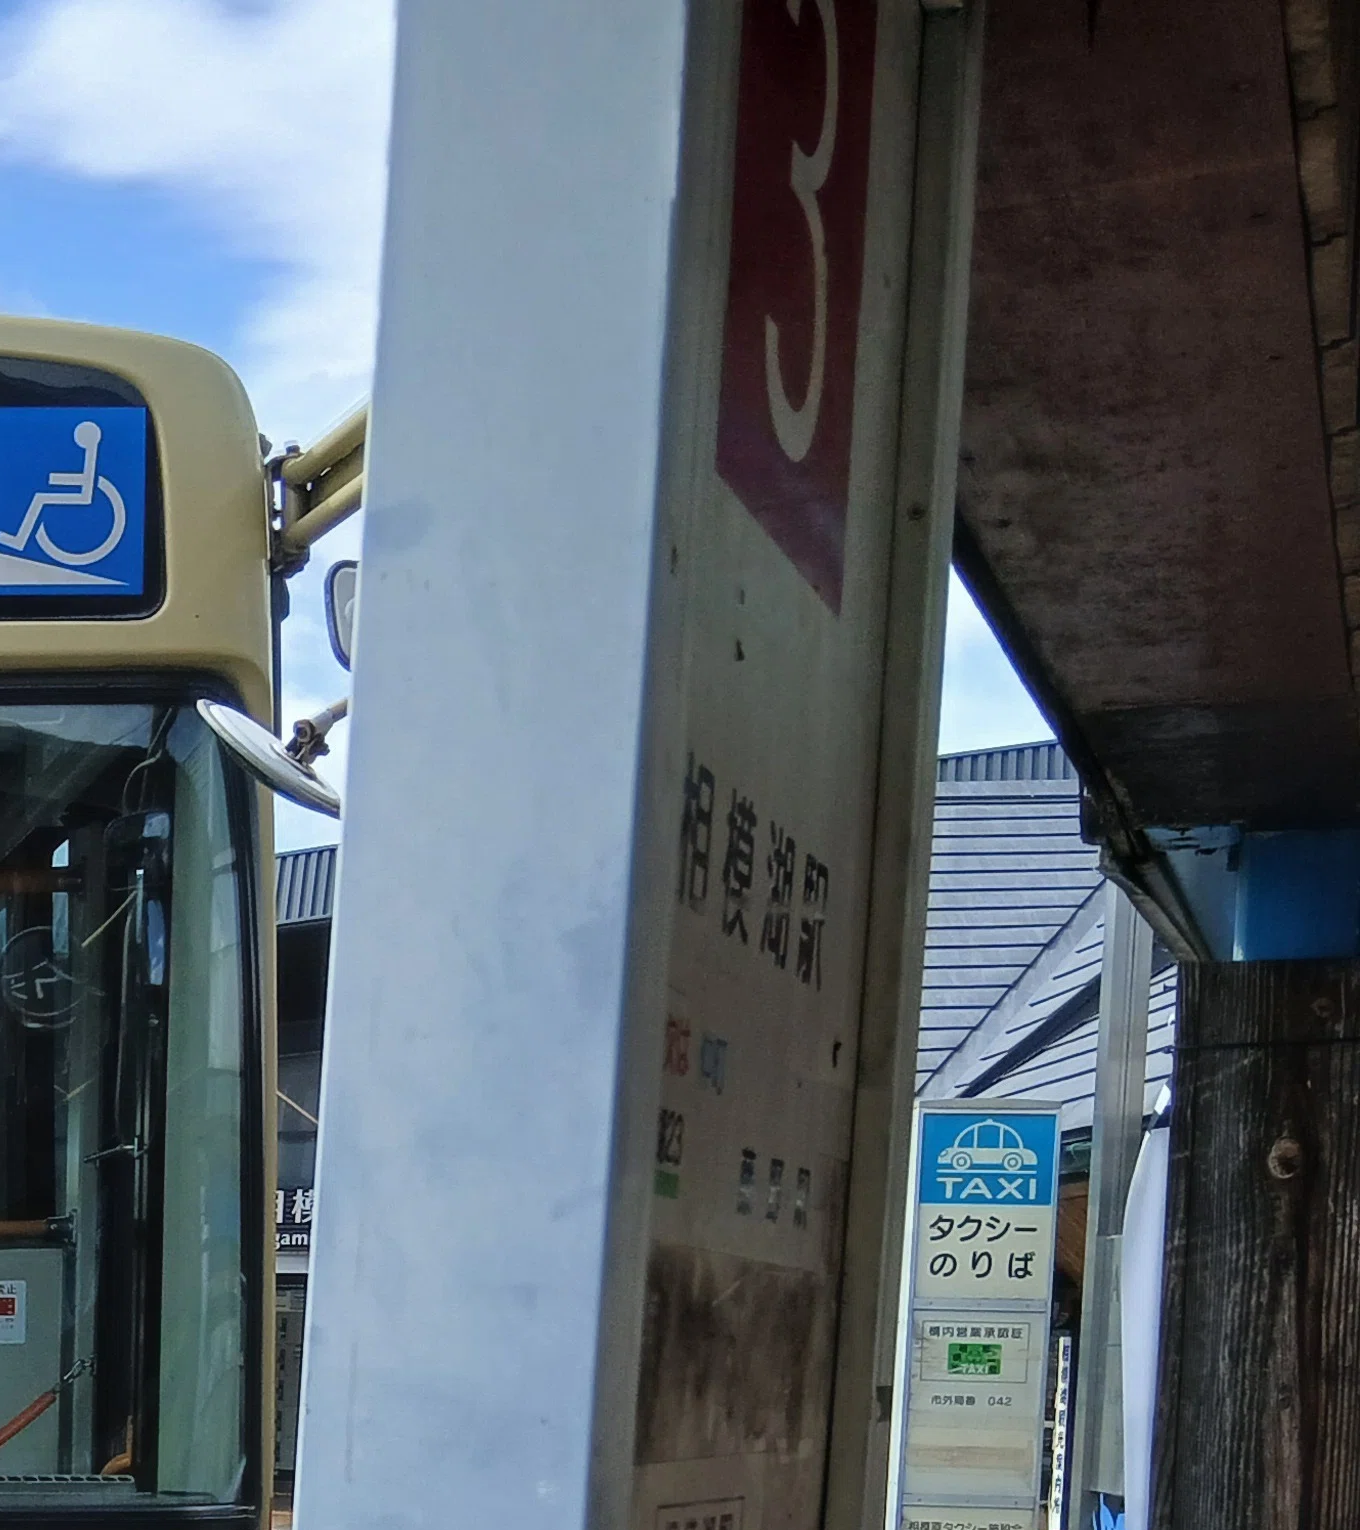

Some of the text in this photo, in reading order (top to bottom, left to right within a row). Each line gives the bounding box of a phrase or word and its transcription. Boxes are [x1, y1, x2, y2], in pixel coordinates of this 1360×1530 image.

[936, 1177, 1038, 1200] TAXI
[929, 1214, 1038, 1242] タクシー
[928, 1250, 1036, 1280] のりば
[988, 1396, 1012, 1406] 042
